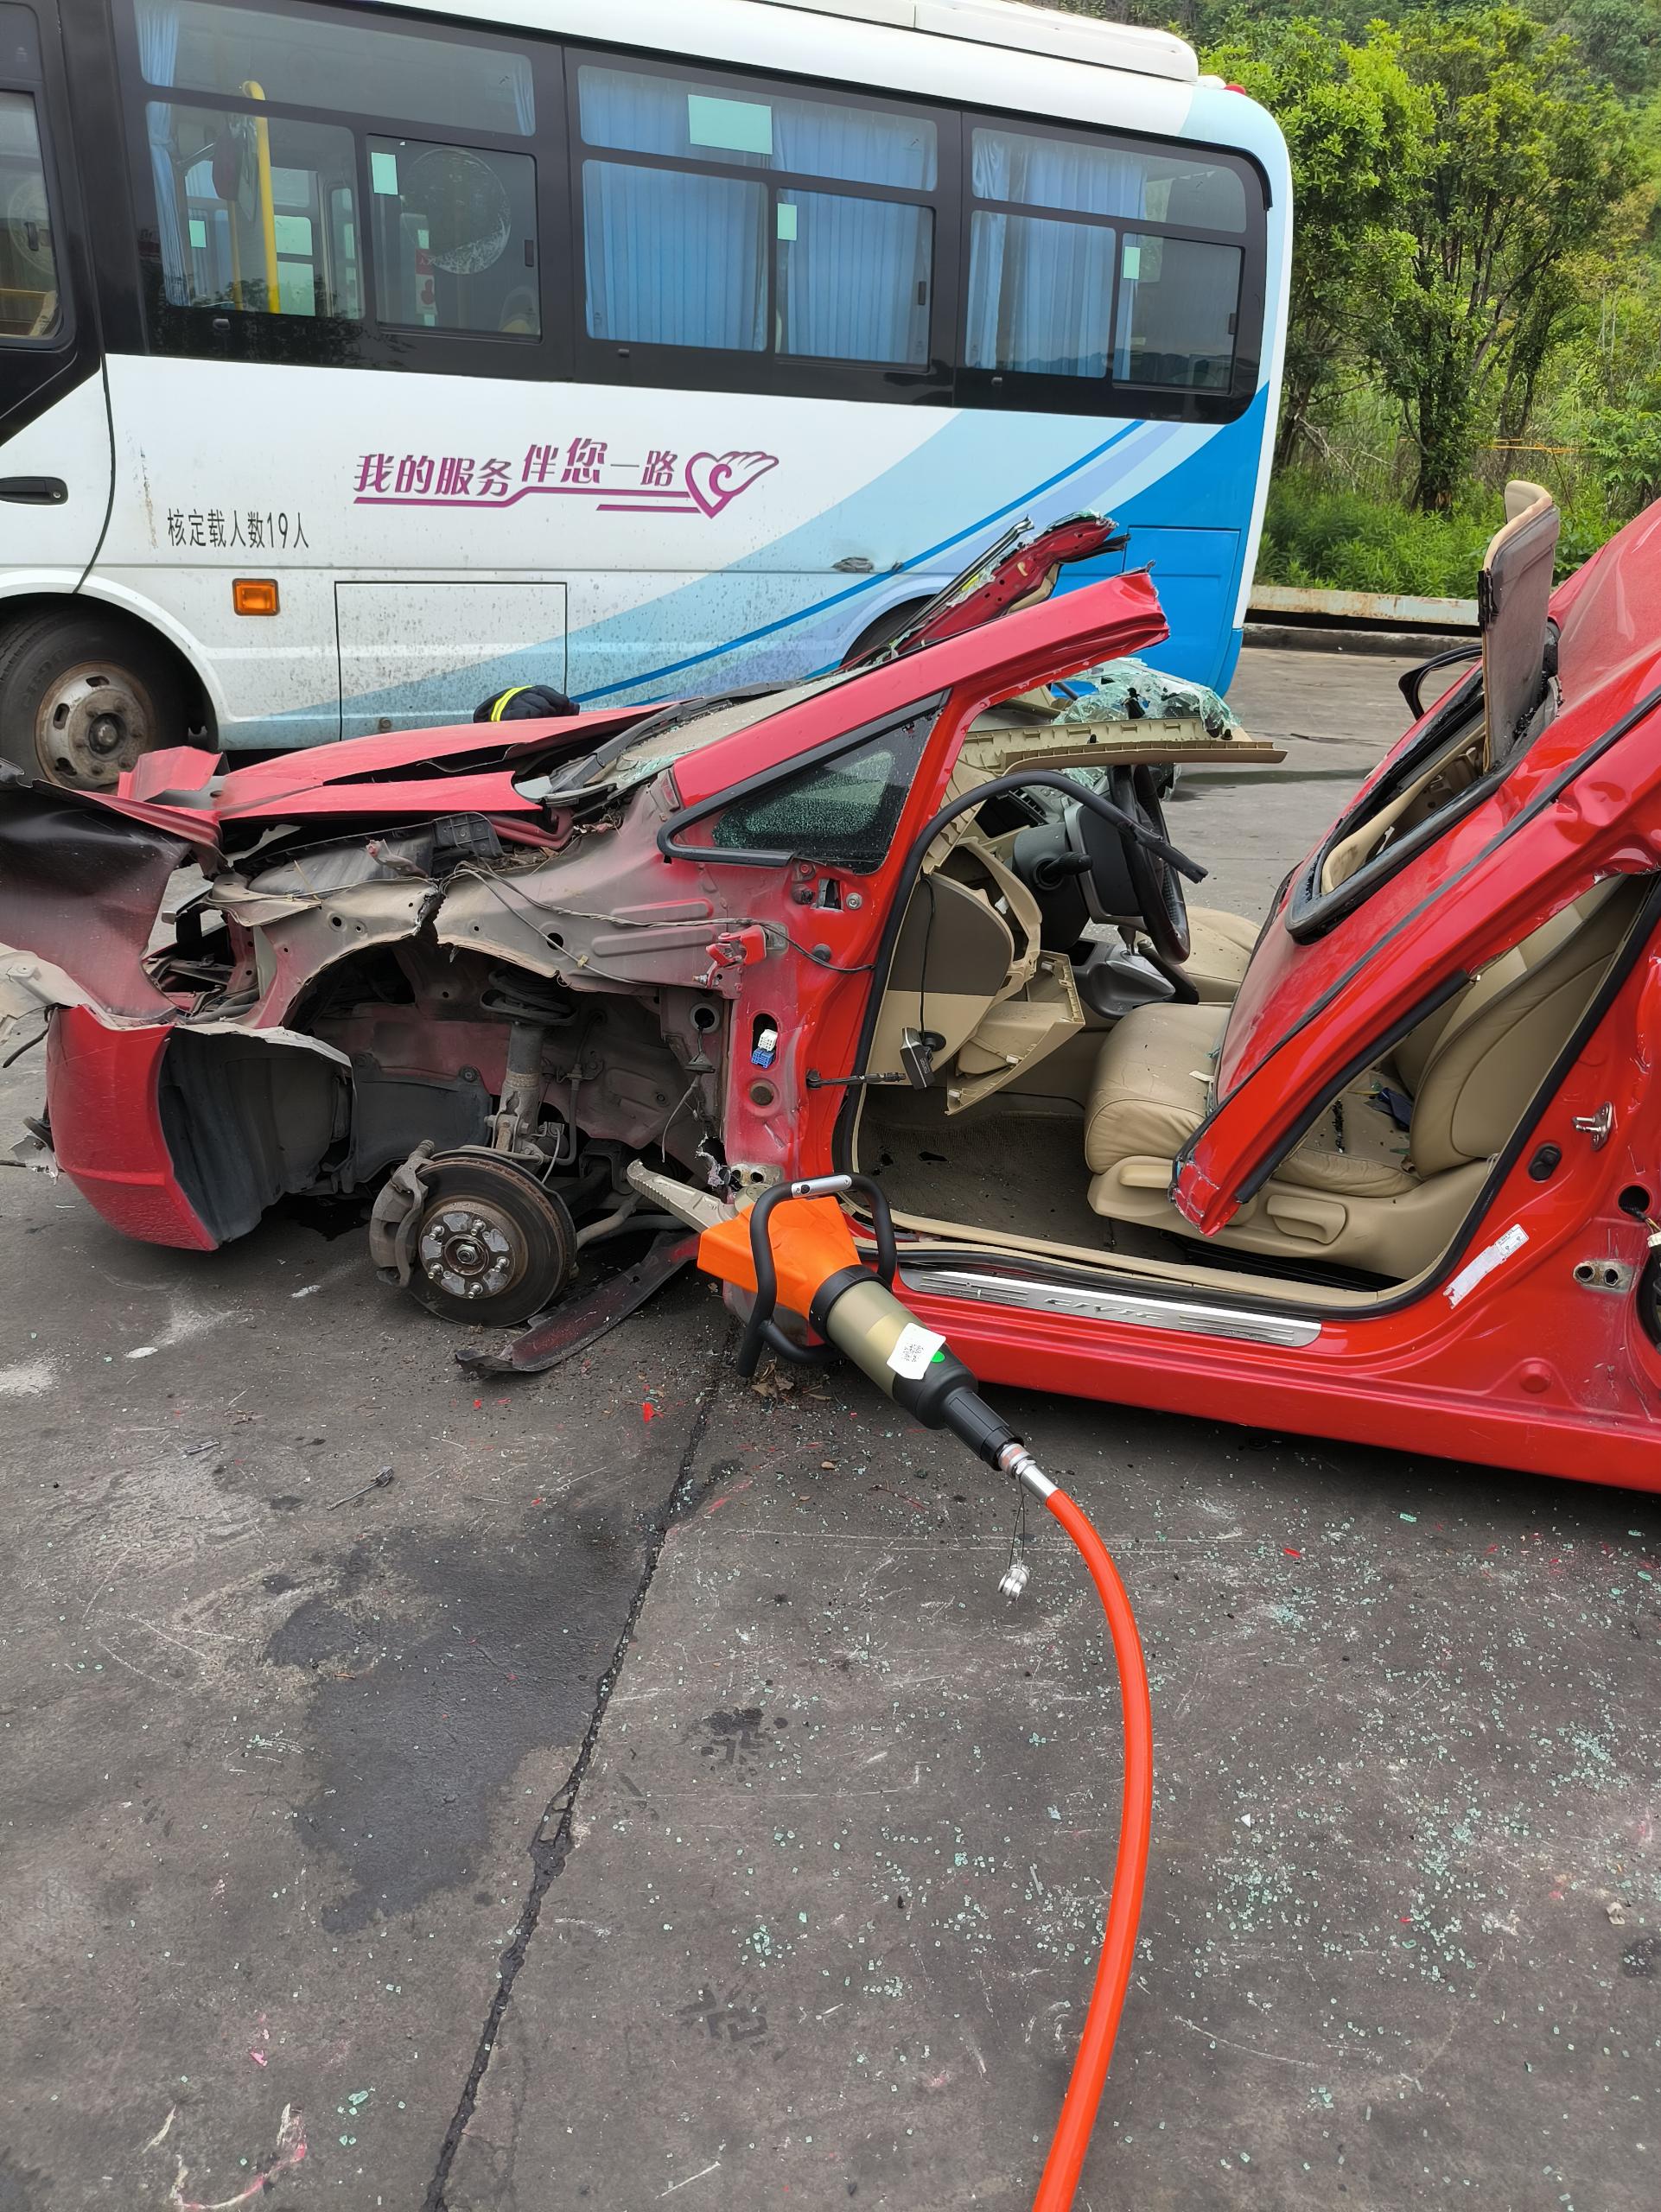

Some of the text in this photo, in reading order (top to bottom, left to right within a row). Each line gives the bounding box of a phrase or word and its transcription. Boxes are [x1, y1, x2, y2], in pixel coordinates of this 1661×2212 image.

[353, 437, 678, 497] 我的服务伴您一路
[168, 508, 309, 549] 核定载人数19人
